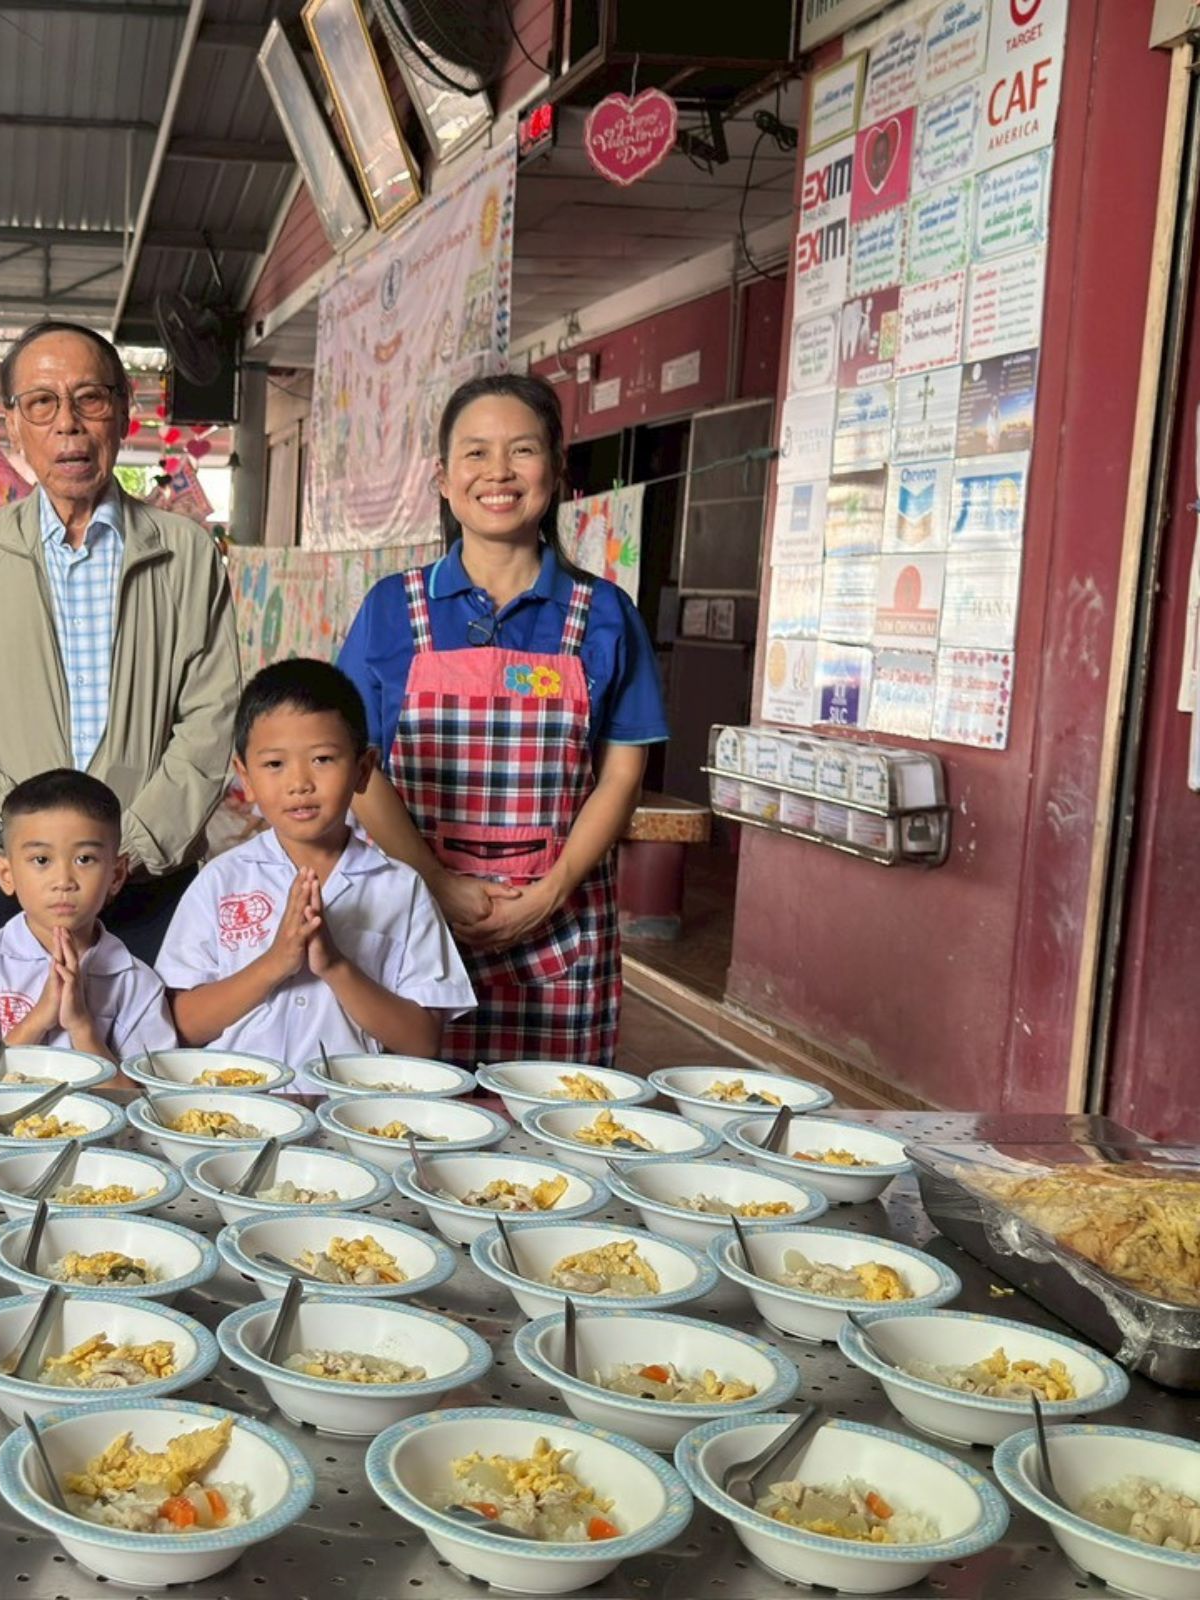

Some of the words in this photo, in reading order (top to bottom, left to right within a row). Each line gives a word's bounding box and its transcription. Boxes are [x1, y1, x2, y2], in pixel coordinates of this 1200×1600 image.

[1006, 22, 1044, 54] TARGET
[987, 57, 1052, 127] CAF
[988, 119, 1039, 152] AMERICA
[803, 154, 853, 211] EXIM
[797, 217, 847, 273] EXIM
[901, 468, 937, 482] Chevron
